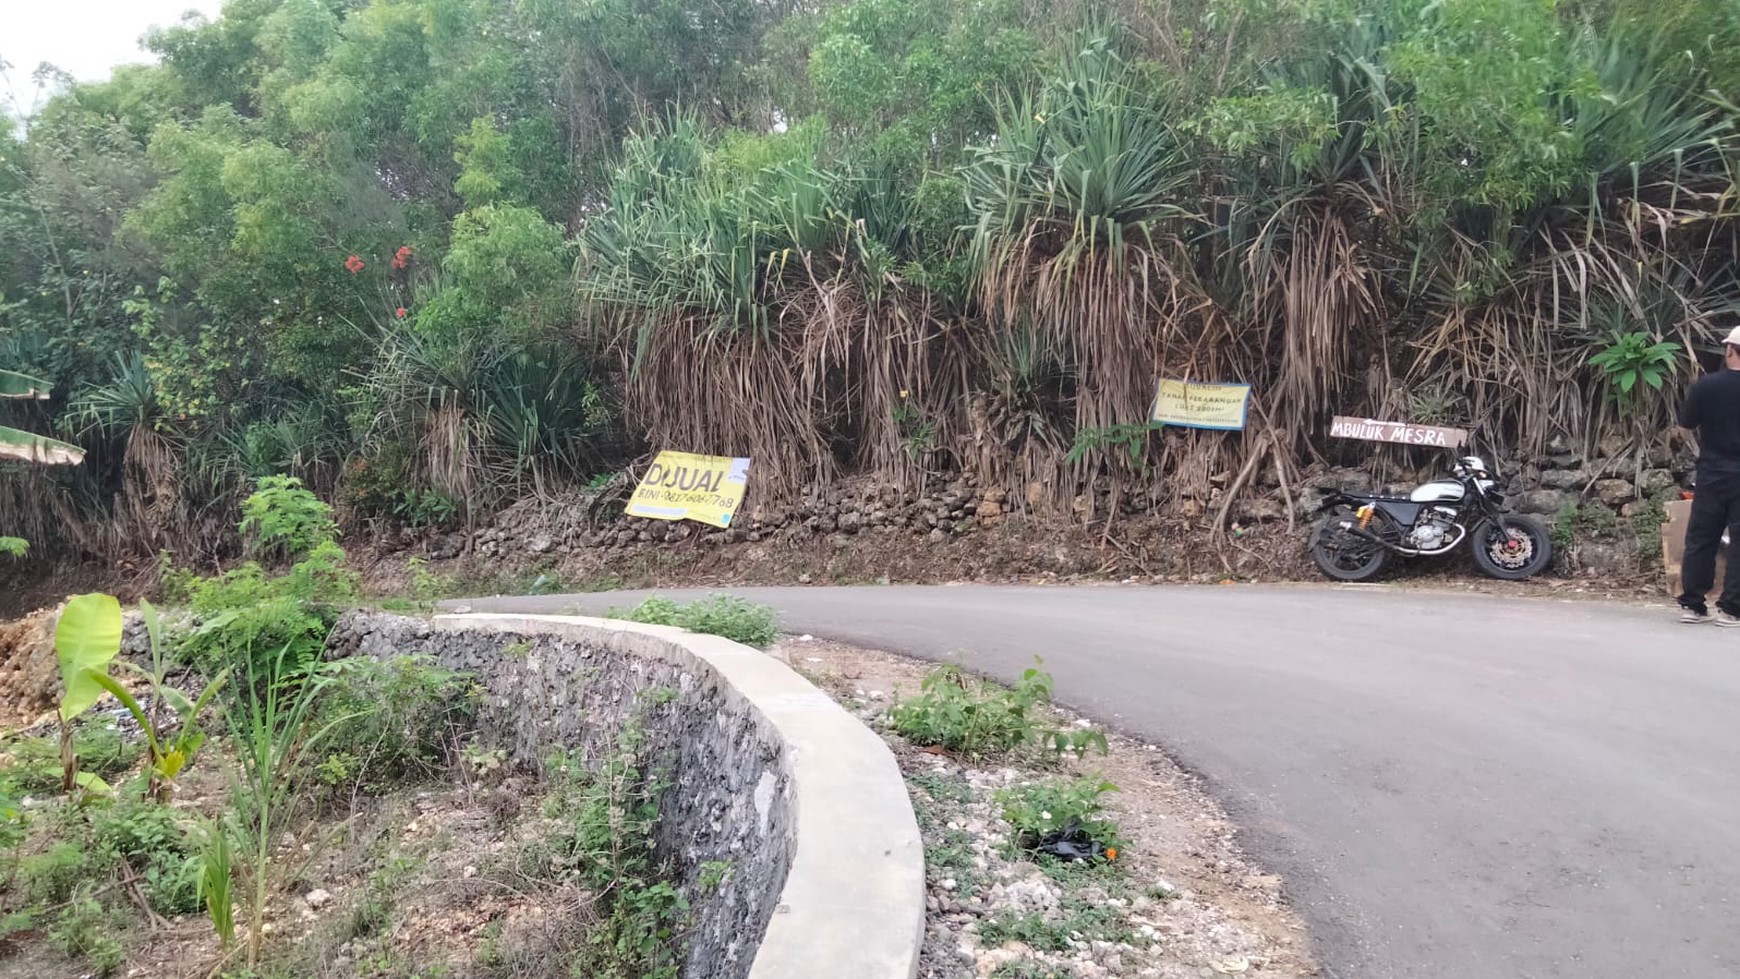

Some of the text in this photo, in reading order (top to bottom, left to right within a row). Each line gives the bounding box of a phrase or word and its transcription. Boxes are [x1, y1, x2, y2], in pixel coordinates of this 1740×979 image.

[1330, 422, 1446, 446] MBULUK MESRA
[645, 463, 724, 492] DIJUAL
